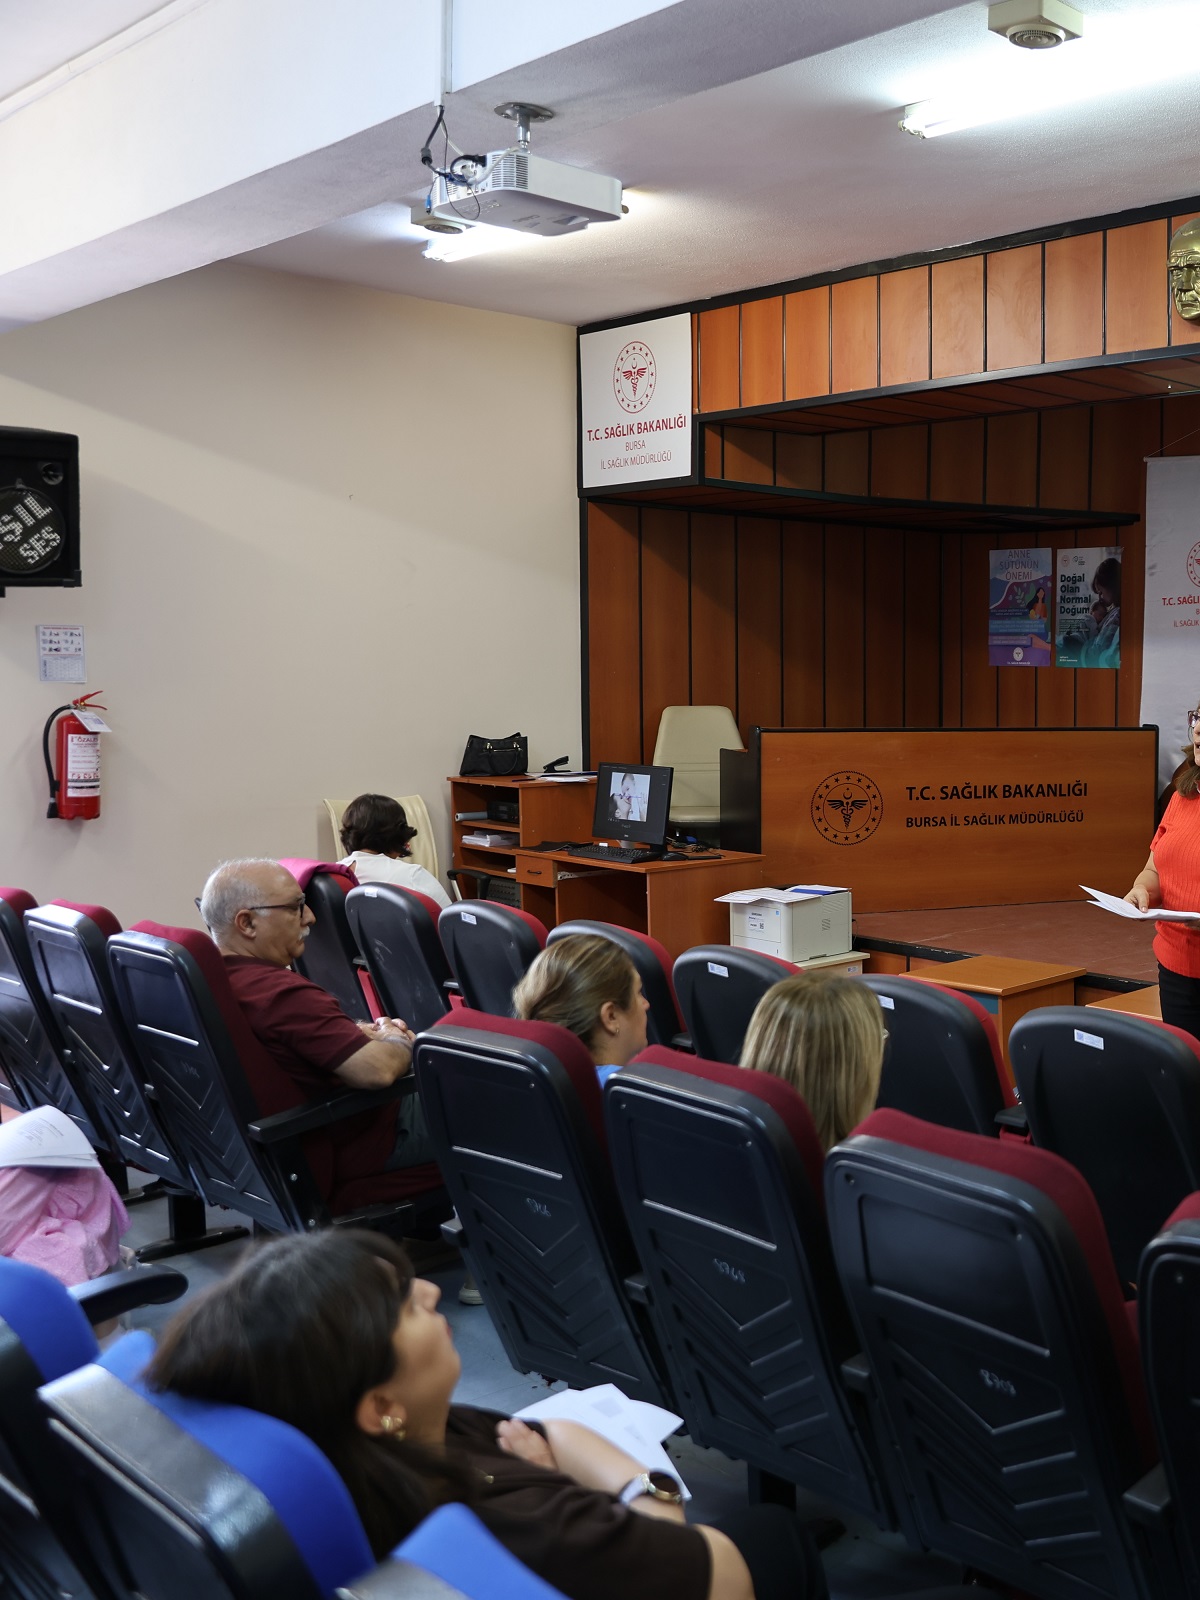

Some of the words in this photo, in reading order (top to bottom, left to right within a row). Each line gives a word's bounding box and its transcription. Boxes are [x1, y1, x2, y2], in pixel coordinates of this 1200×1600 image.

[587, 429, 603, 442] T.C.
[604, 423, 636, 439] SAĞLIK
[637, 414, 687, 435] BAKANLIĞI
[625, 439, 646, 451] BURSA
[601, 458, 607, 470] İL
[607, 454, 629, 469] SAĞLIK
[630, 450, 672, 466] MÜDÜRLÜĞÜ
[18, 525, 61, 565] SES
[1007, 550, 1031, 559] ANNE
[1005, 571, 1033, 581] ÖNEMİ
[1060, 573, 1085, 585] Doğal
[1060, 585, 1080, 594] Olan
[1060, 594, 1091, 604] Normal
[1162, 597, 1175, 606] T.C.
[1059, 605, 1090, 616] Doğum
[1180, 619, 1199, 627] SAĞLIK
[906, 786, 935, 801] T.C.
[940, 782, 999, 800] SAĞLIK
[1002, 779, 1088, 799] BAKANLIĞI
[906, 815, 947, 828] BURSA
[950, 813, 961, 827] İL
[963, 812, 1006, 826] SAĞLIK
[1009, 810, 1084, 825] MÜDÜRLÜĞÜ
